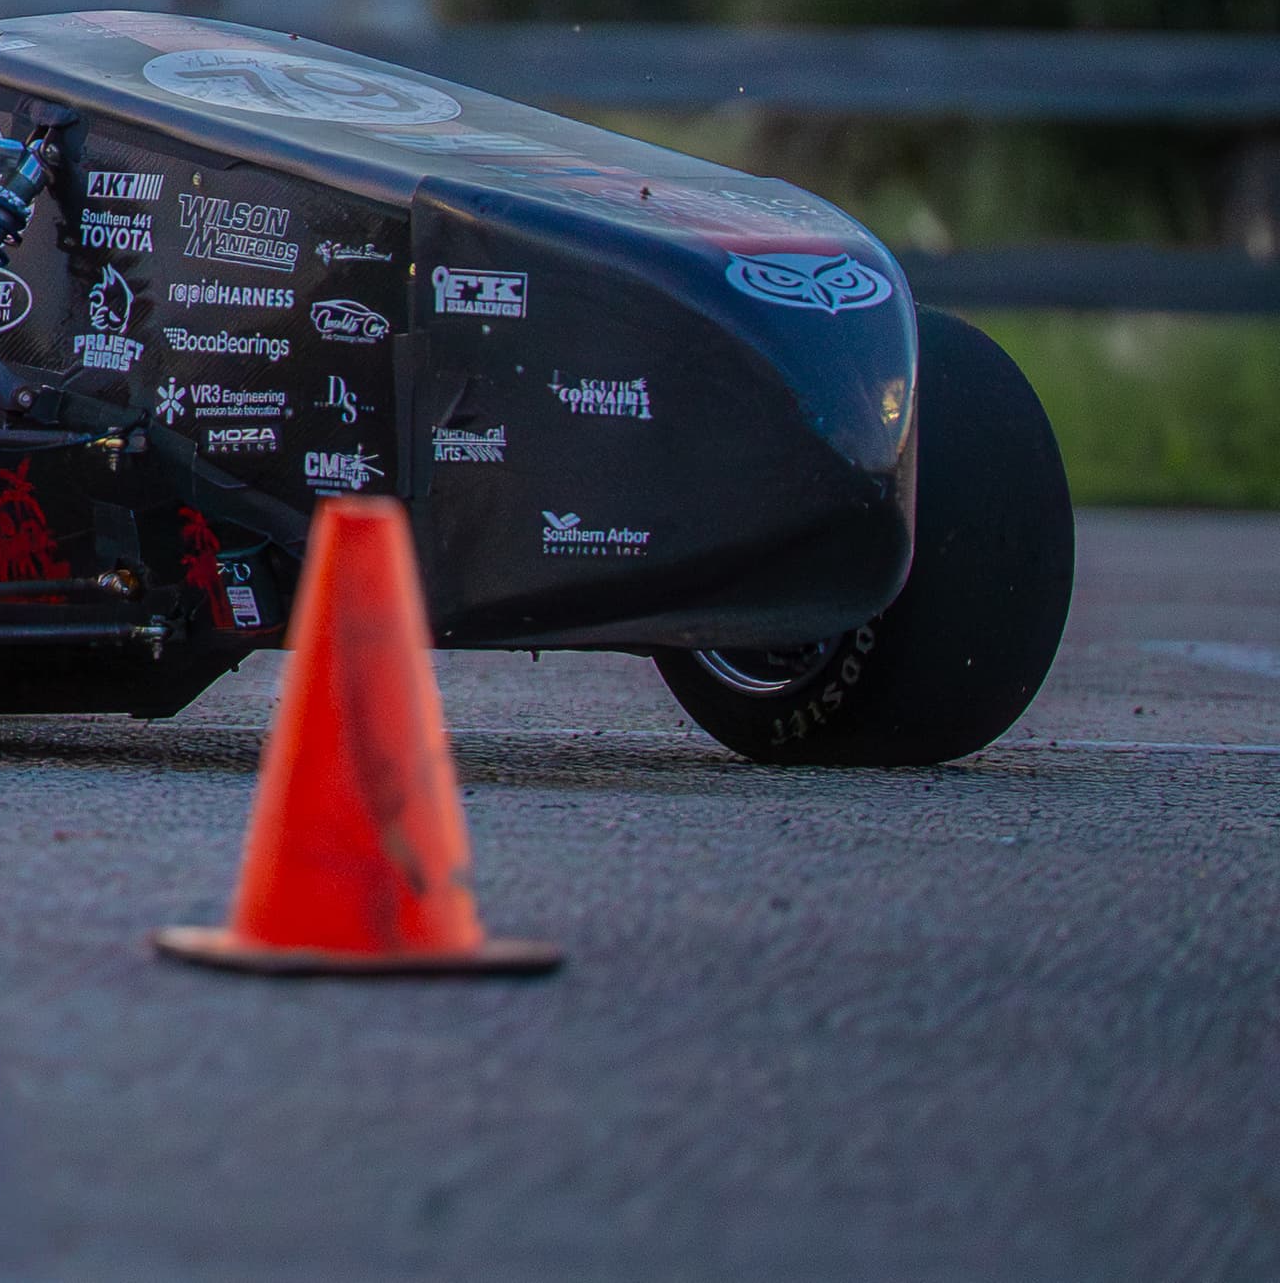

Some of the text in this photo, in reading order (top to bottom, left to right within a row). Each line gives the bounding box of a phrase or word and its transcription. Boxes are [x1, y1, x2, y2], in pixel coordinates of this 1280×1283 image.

[175, 67, 424, 113] 79
[90, 173, 135, 197] AKT
[81, 208, 152, 229] Southern 441
[178, 193, 290, 237] WILSON
[80, 224, 153, 252] TOYOTA
[184, 225, 299, 262] MANIFOLDS
[168, 279, 295, 309] rapidHARNESS
[445, 274, 522, 303] FK
[446, 299, 522, 317] BEARINGS
[73, 334, 144, 361] PROJECT
[176, 328, 290, 361] BocaBearings
[83, 350, 130, 372] EUROS
[190, 384, 286, 406] VR3 Engineering
[208, 428, 276, 441] MOZA
[208, 441, 277, 452] RACING
[434, 443, 461, 461] Arts
[543, 526, 650, 543] Southern Arbor
